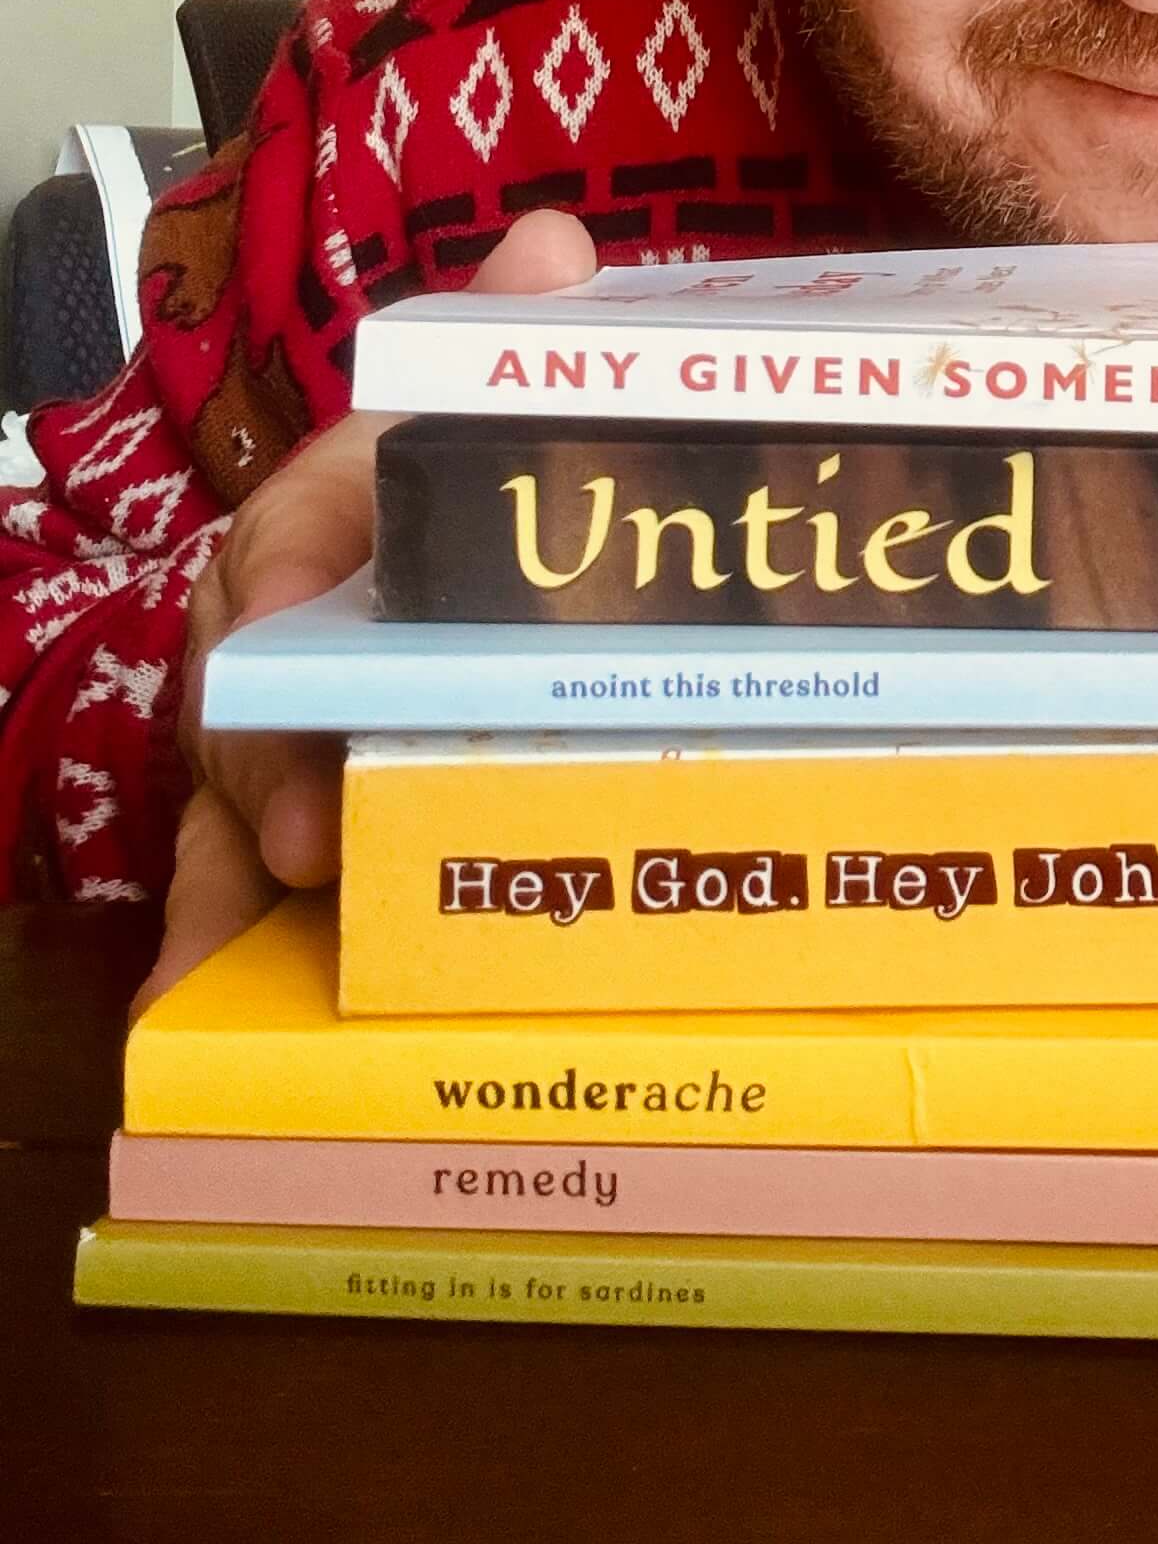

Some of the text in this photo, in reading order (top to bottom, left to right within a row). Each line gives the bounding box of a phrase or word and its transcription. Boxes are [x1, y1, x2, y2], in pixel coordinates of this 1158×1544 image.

[486, 349, 639, 390] ANY
[679, 353, 900, 397] GIVEN
[500, 451, 1051, 595] Untied
[551, 671, 880, 699] anoint this threshold
[442, 859, 603, 924] Hey
[635, 856, 802, 910] God.
[827, 855, 985, 919] Hey
[433, 1067, 766, 1113] wonderache
[433, 1159, 618, 1208] remedy
[346, 1271, 705, 1304] fitting in is for sardines
